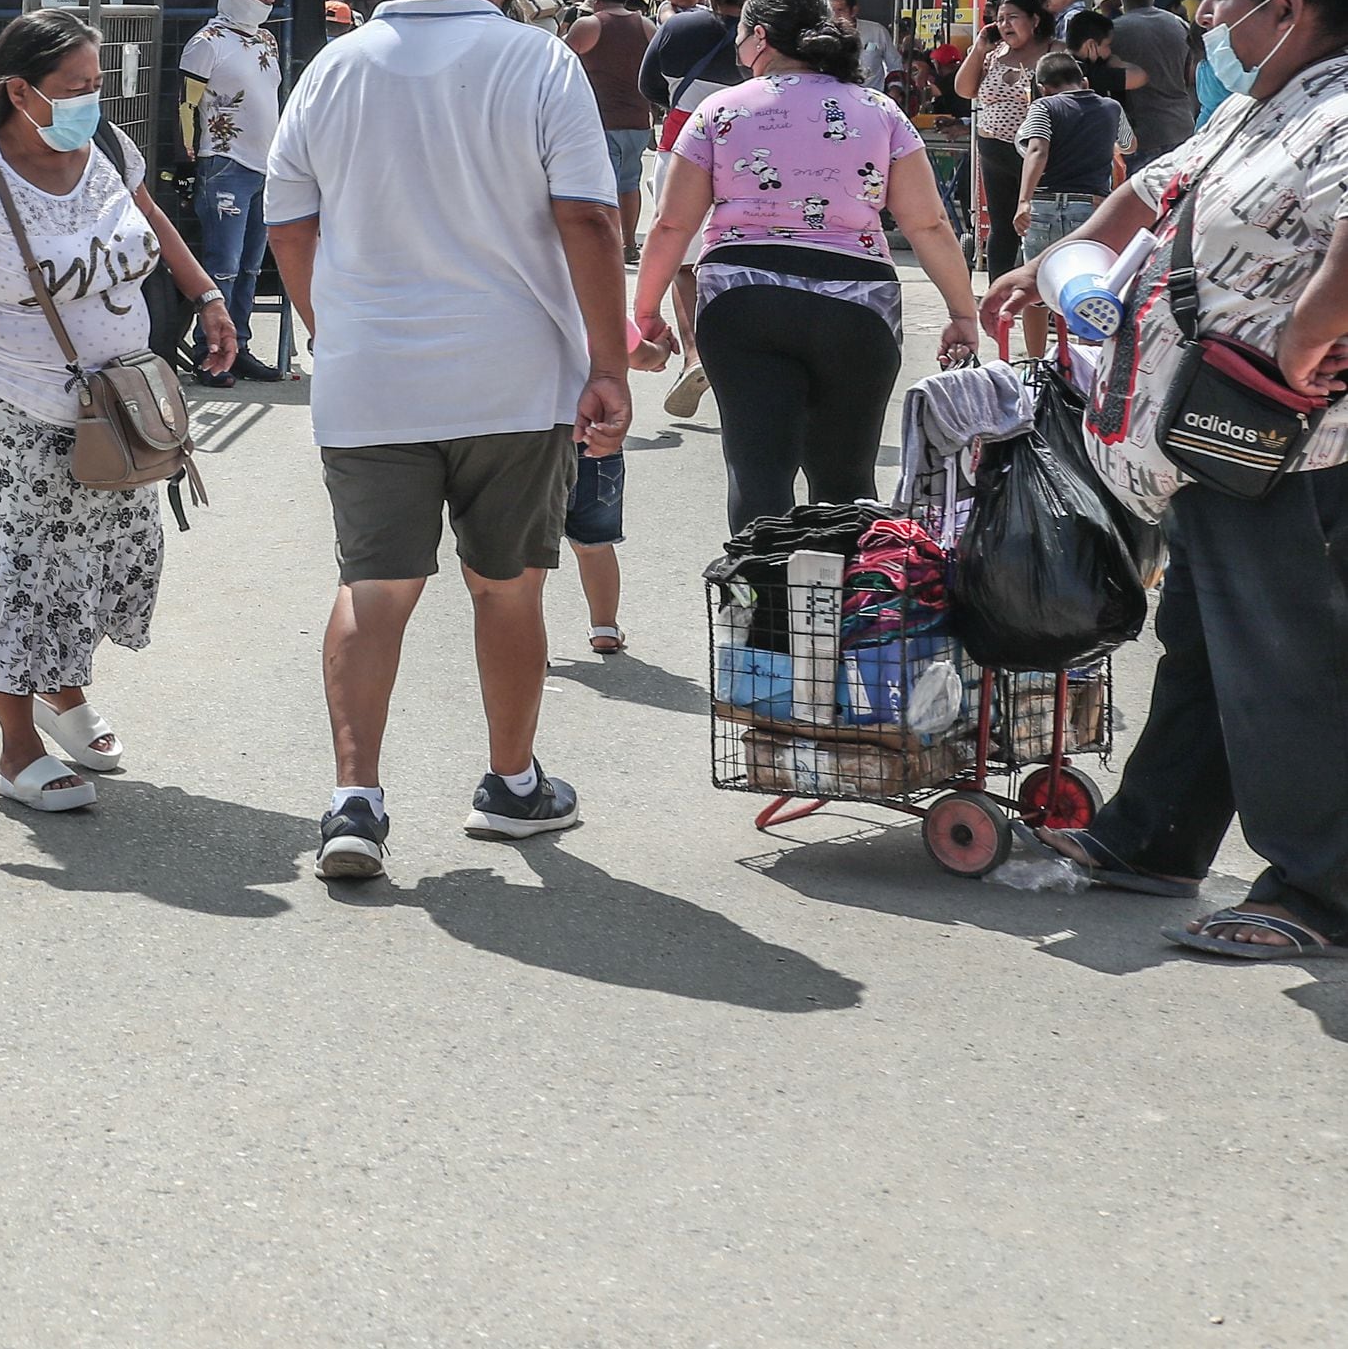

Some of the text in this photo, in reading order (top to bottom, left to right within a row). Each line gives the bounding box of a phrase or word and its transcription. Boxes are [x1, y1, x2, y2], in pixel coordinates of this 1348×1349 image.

[755, 107, 790, 120] mickey
[792, 167, 841, 182] Love
[1184, 411, 1258, 443] adidas
